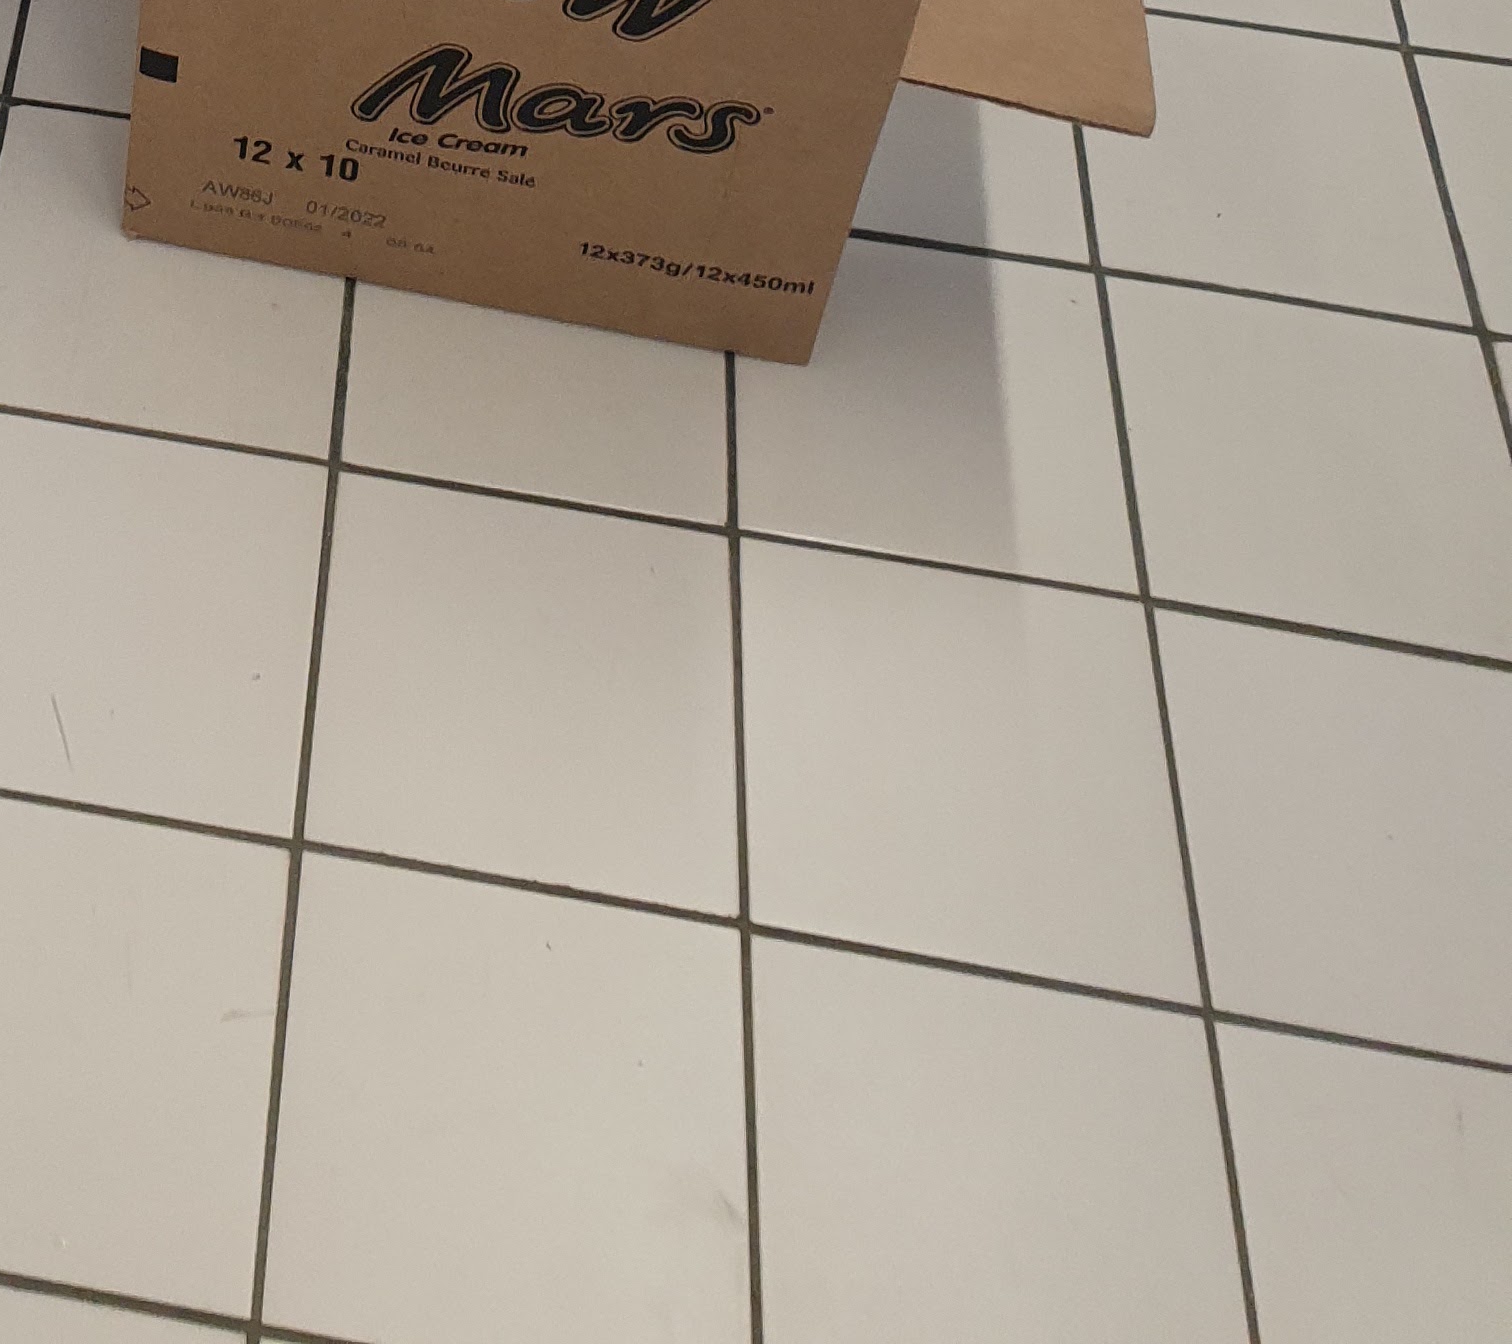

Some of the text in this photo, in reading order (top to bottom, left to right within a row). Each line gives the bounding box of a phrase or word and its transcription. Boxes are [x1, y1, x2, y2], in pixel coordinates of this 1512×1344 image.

[350, 43, 761, 153] Mars
[231, 135, 360, 183] 12 x 10
[345, 138, 421, 166] Caramel
[427, 155, 491, 180] Beurre
[388, 127, 529, 157] Ice Cream
[579, 239, 816, 299] 12x373g/12x450ml
